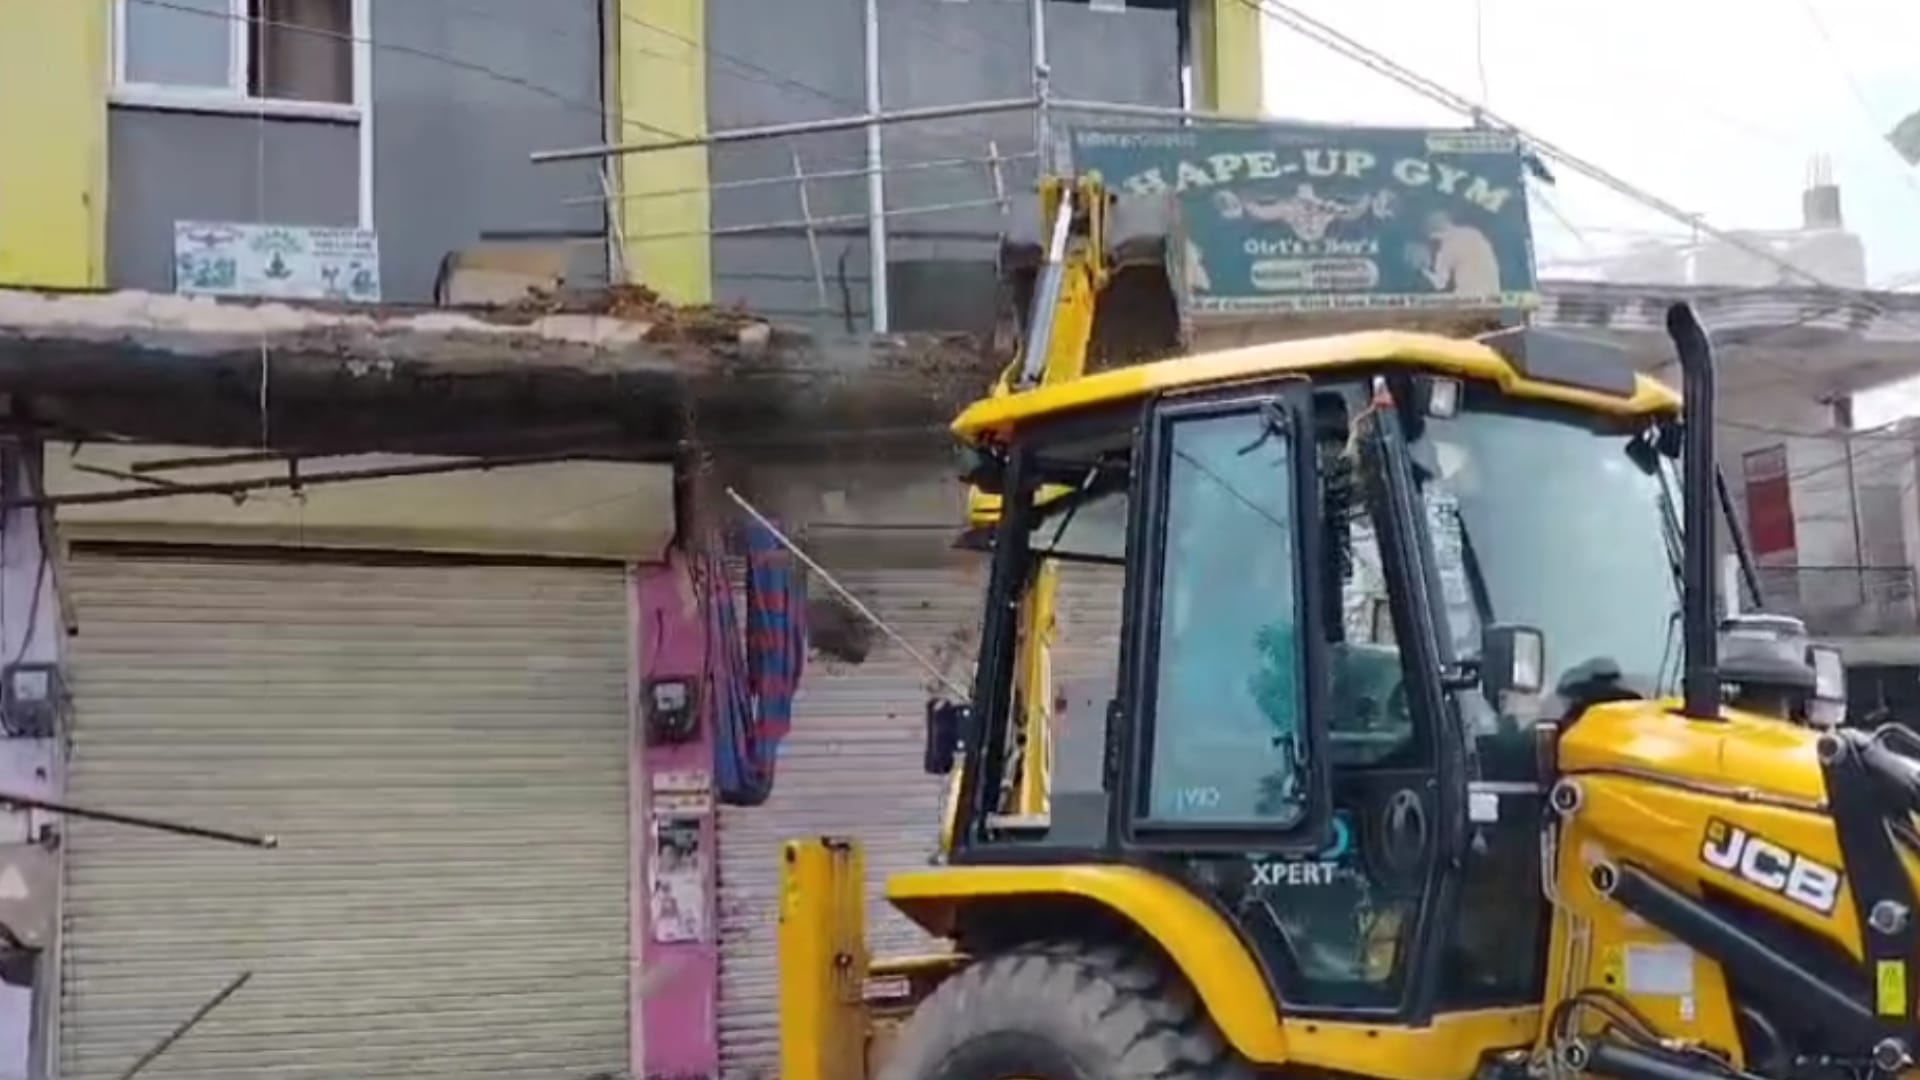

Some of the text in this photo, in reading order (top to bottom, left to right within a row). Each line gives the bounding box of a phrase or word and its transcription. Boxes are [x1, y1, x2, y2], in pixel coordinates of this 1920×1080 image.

[1122, 150, 1511, 213] HAPE-UP GYM
[1251, 862, 1337, 886] XPERT
[1702, 827, 1838, 911] JCB
